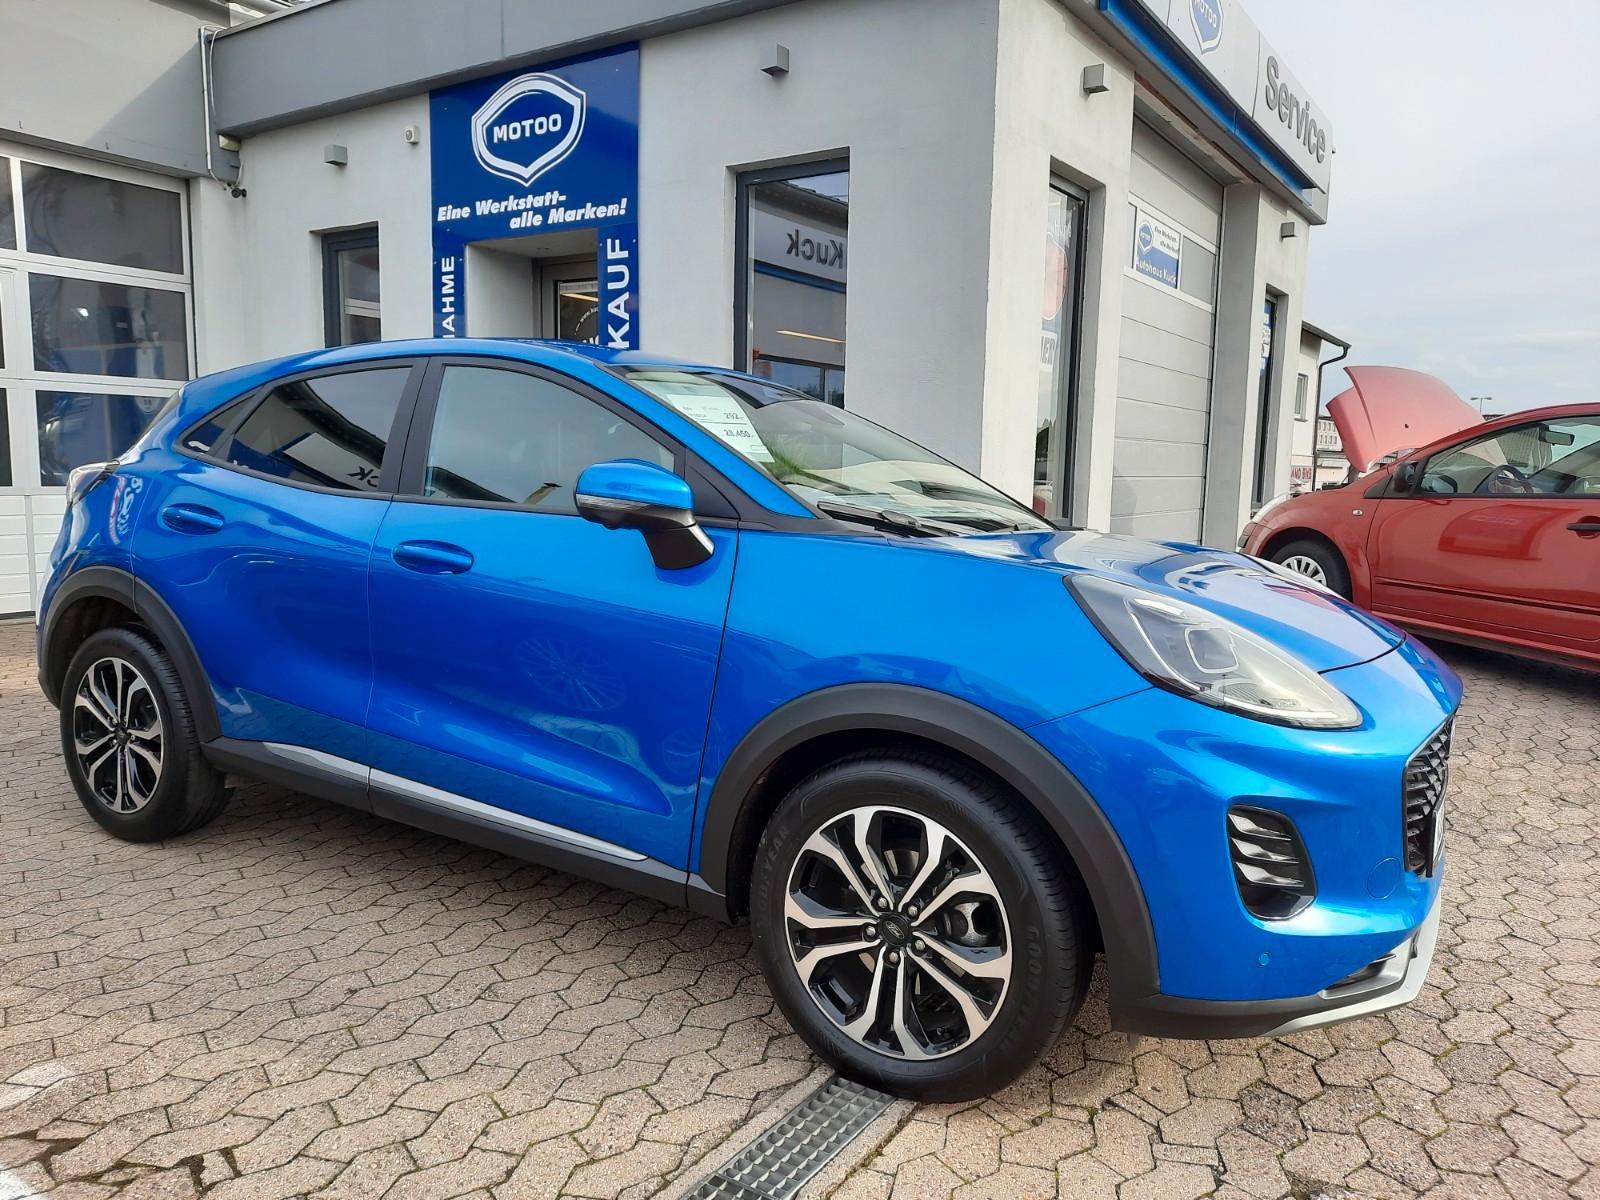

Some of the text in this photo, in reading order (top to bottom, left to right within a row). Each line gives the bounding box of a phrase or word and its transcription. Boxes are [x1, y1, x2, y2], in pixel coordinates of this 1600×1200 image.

[1265, 56, 1326, 163] Service
[493, 113, 562, 143] MOTOO
[437, 191, 566, 221] Eine Werkstatt-
[509, 198, 627, 229] alle Marken!
[606, 238, 630, 349] KAUF
